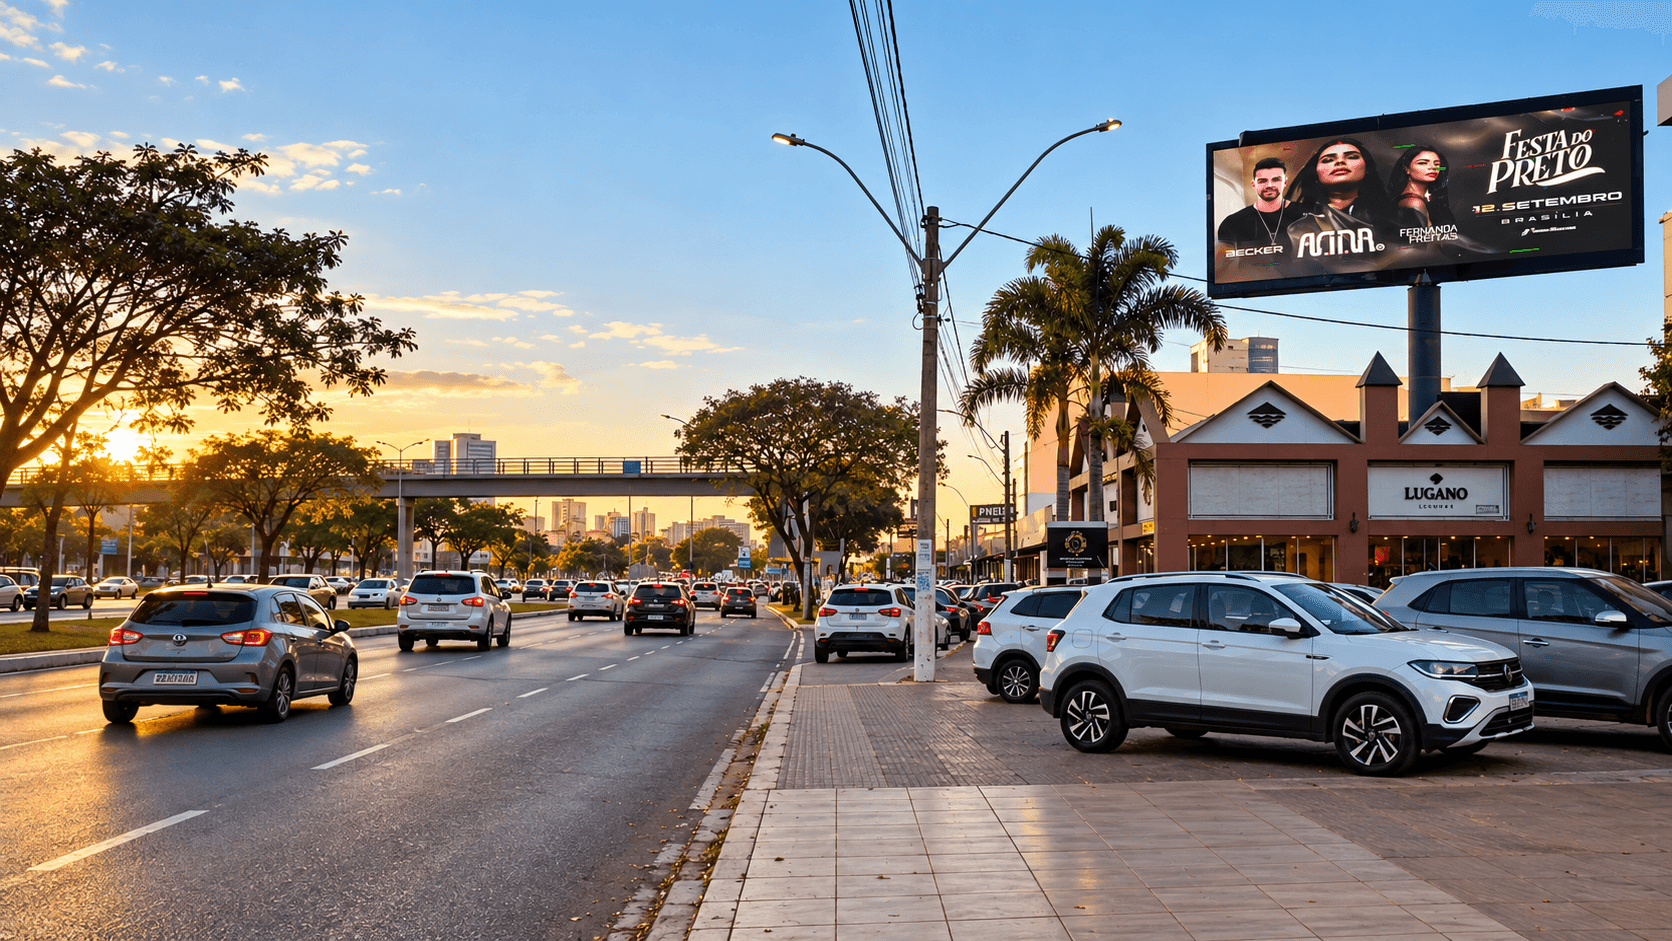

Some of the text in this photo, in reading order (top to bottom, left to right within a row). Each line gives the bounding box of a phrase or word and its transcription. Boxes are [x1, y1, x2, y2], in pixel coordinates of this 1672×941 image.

[1501, 129, 1593, 160] FESTA DO
[1486, 144, 1594, 195] PRETO
[1399, 223, 1458, 239] FERNANDA
[1409, 232, 1459, 245] FREITAS
[1404, 486, 1468, 501] LUGANO
